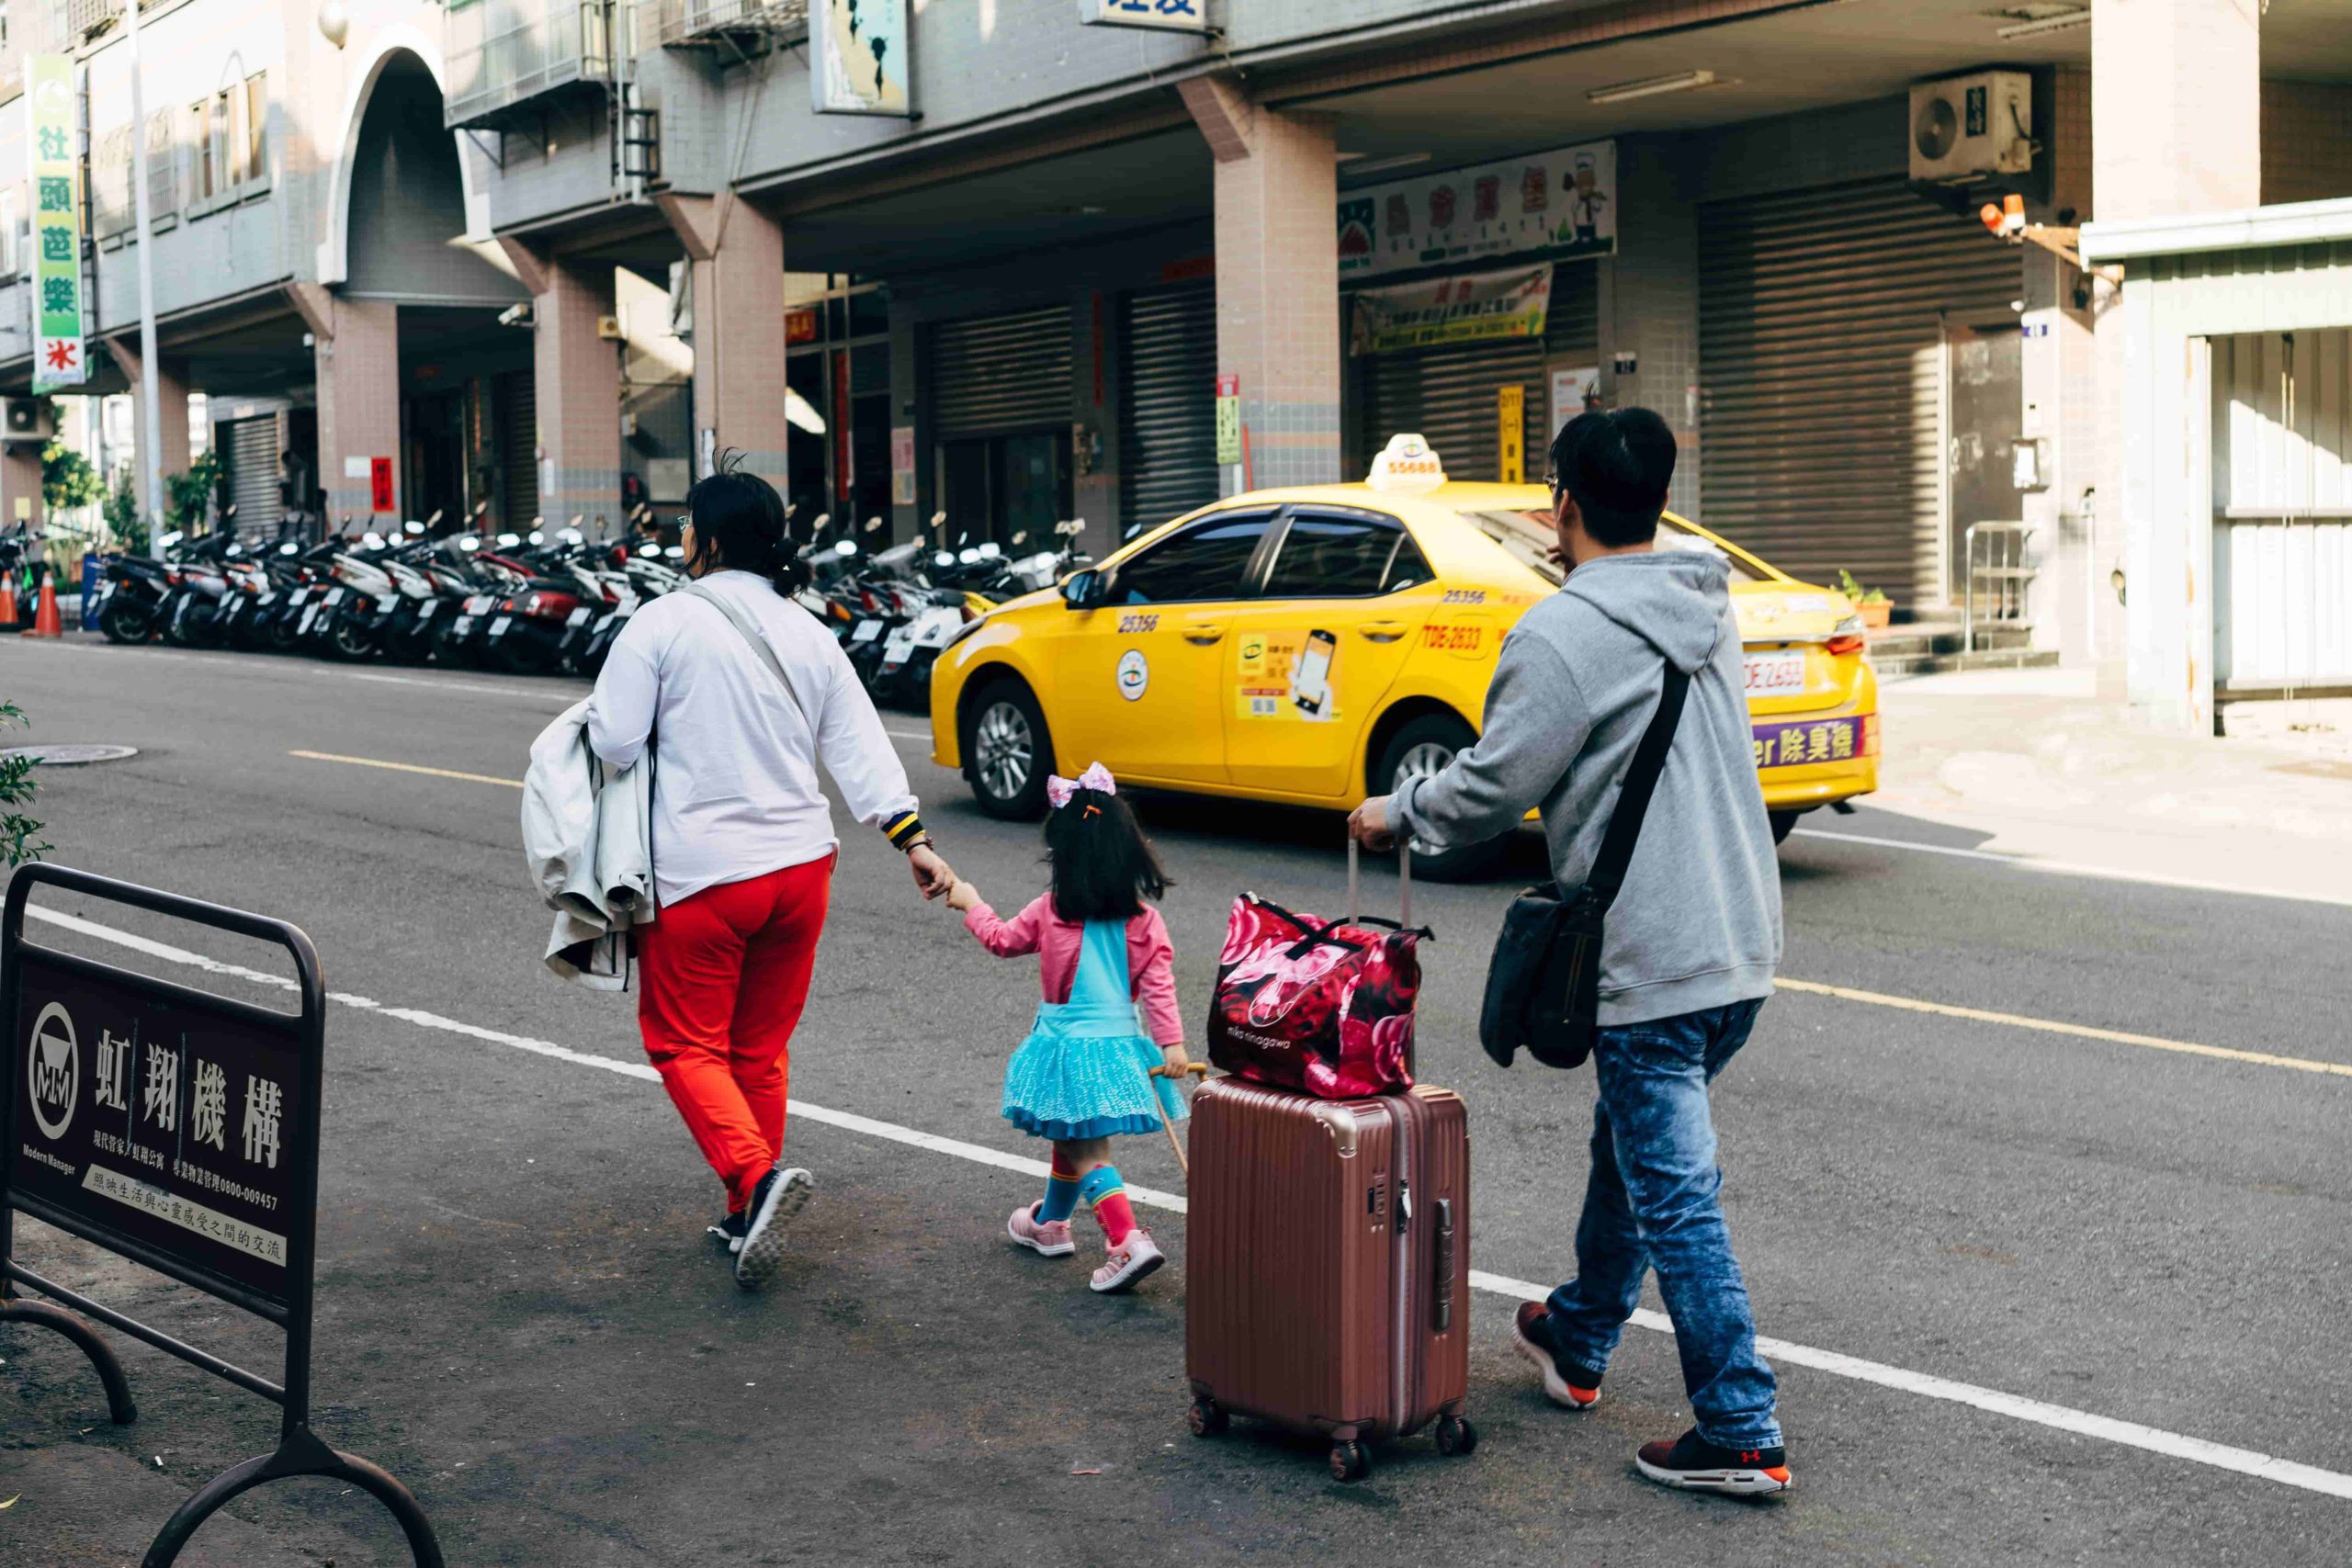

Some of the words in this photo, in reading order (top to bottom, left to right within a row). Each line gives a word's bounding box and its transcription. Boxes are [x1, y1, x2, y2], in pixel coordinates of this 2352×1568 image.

[1388, 461, 1437, 473] 55688
[1442, 590, 1486, 604] 25356
[1118, 614, 1160, 634] 25356
[96, 1029, 283, 1168] 虹翔機構
[23, 1144, 48, 1163] Modern
[48, 1153, 75, 1175] Manager
